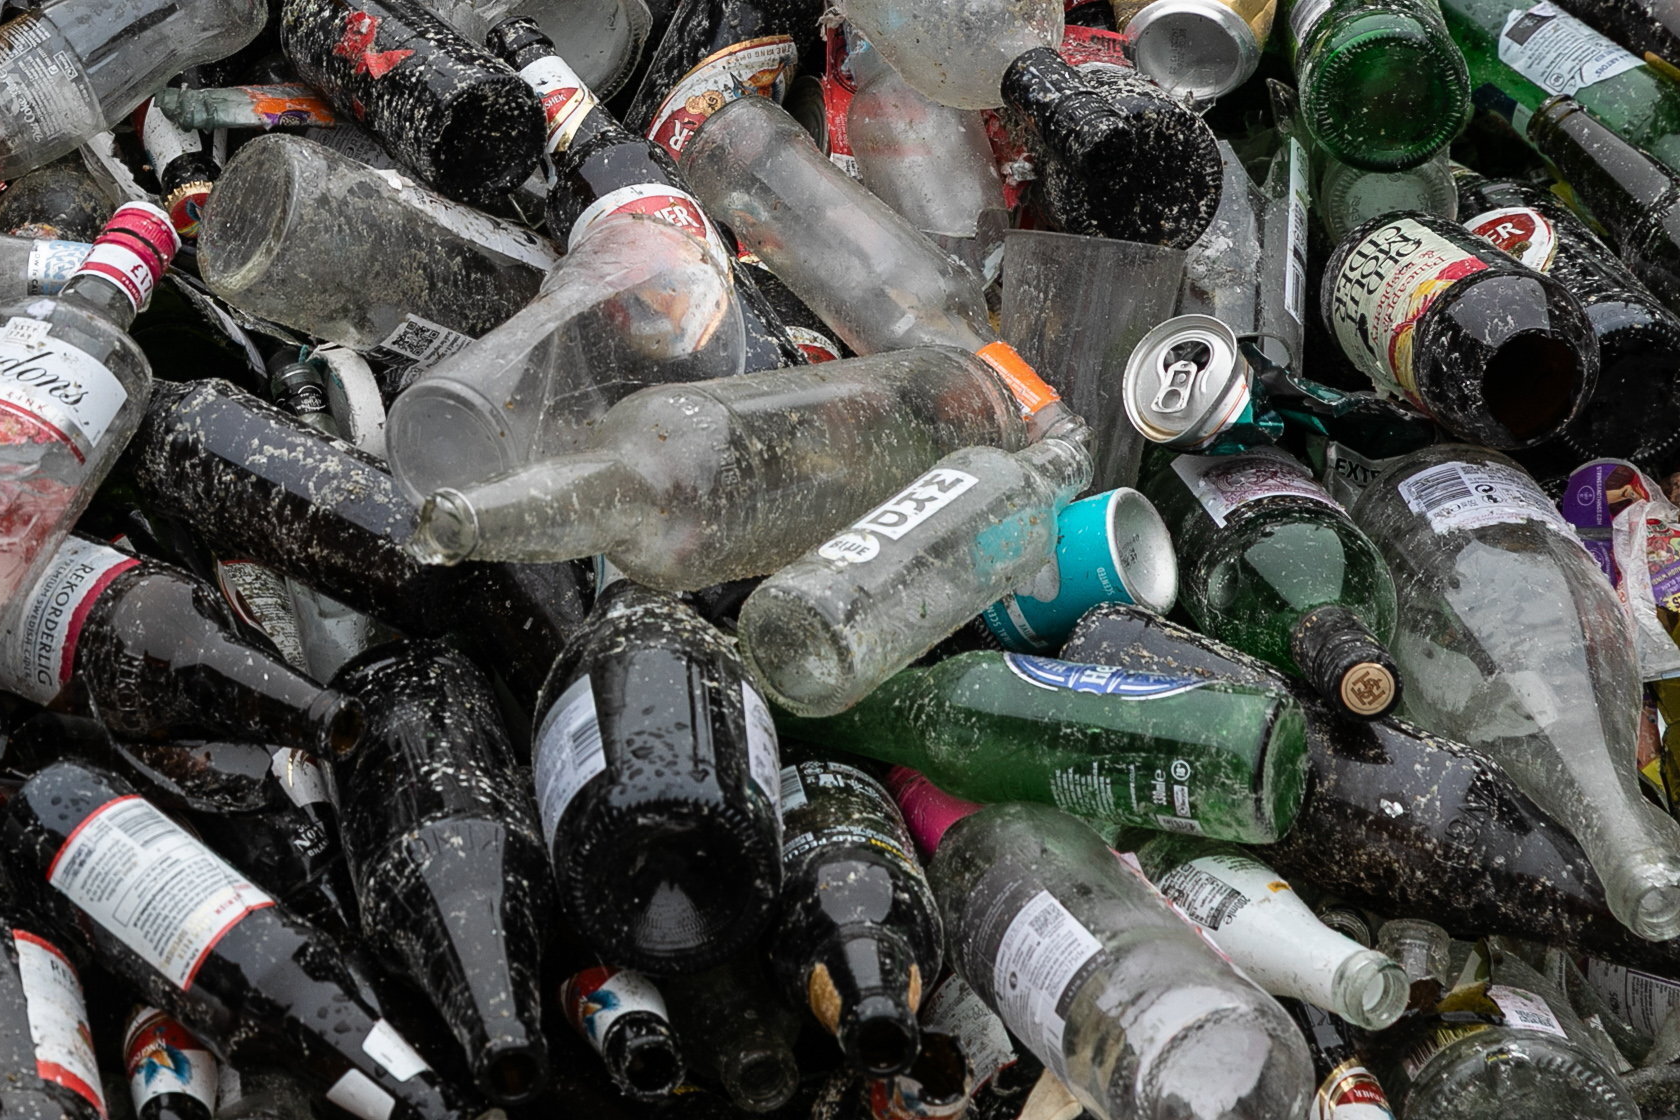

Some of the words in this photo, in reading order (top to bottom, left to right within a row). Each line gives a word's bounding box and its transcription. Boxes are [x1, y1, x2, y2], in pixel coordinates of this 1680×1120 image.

[1334, 225, 1403, 321] CIDER
[1365, 233, 1423, 298] OLD
[830, 539, 870, 558] BLUE
[45, 557, 70, 600] PREMIUM
[25, 599, 47, 648] SWEDISH
[38, 563, 94, 687] REKORDERLIG
